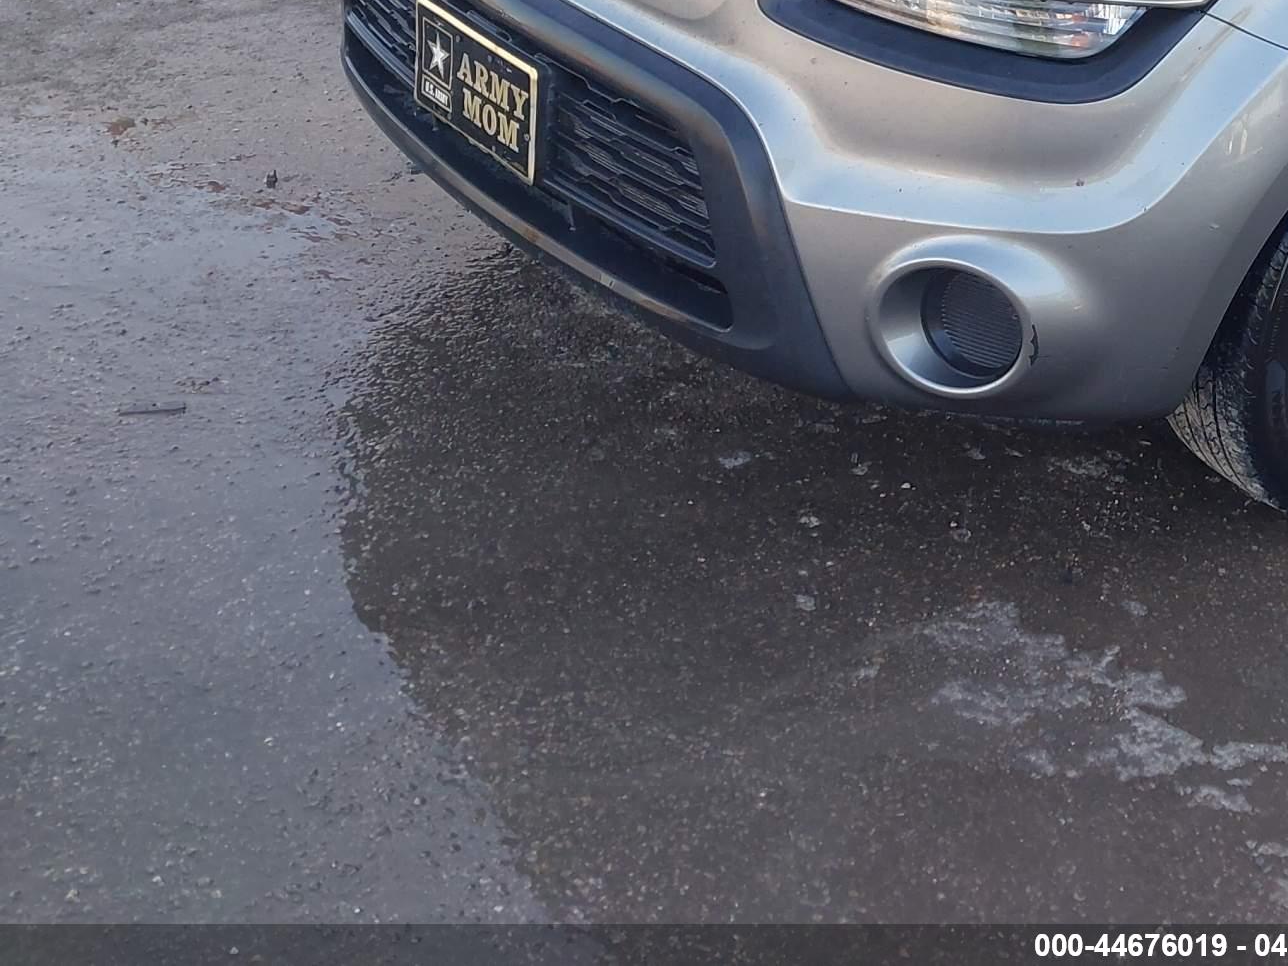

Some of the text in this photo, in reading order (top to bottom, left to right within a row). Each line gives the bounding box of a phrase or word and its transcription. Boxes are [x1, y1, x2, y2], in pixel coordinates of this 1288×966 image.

[425, 80, 449, 106] U.S. ARMY
[456, 52, 530, 121] ARMY
[462, 88, 520, 153] MOM
